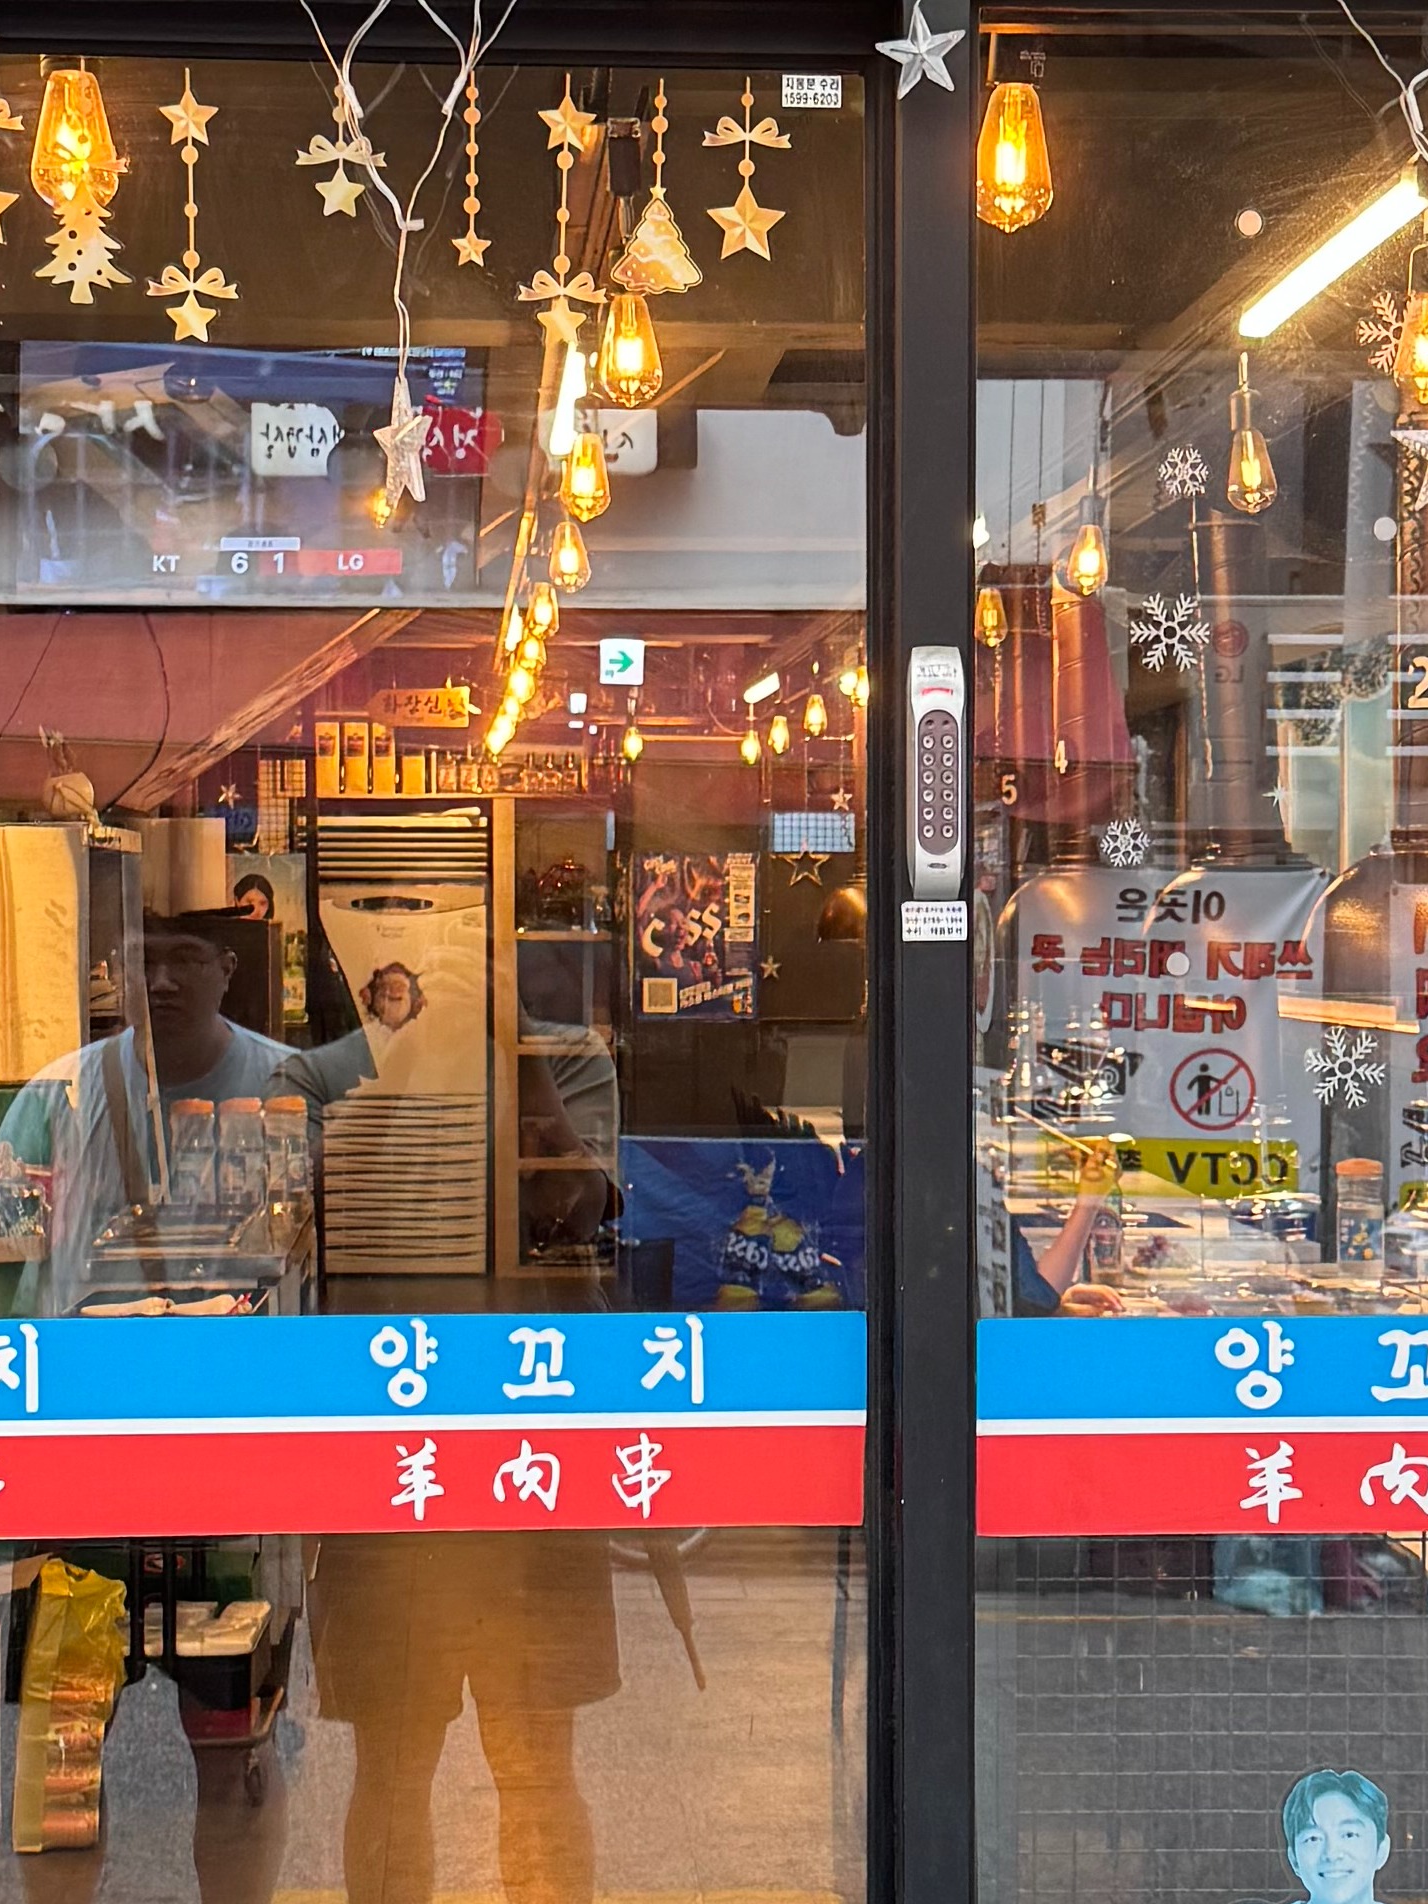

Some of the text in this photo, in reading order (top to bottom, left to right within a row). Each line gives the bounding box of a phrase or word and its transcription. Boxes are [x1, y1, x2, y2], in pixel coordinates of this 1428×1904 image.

[152, 552, 364, 574] KT 6 1 LG
[1053, 740, 1069, 774] 4
[1000, 774, 1017, 805] 5
[371, 1318, 703, 1406] 양꼬치
[392, 1433, 670, 1520] 羊肉串
